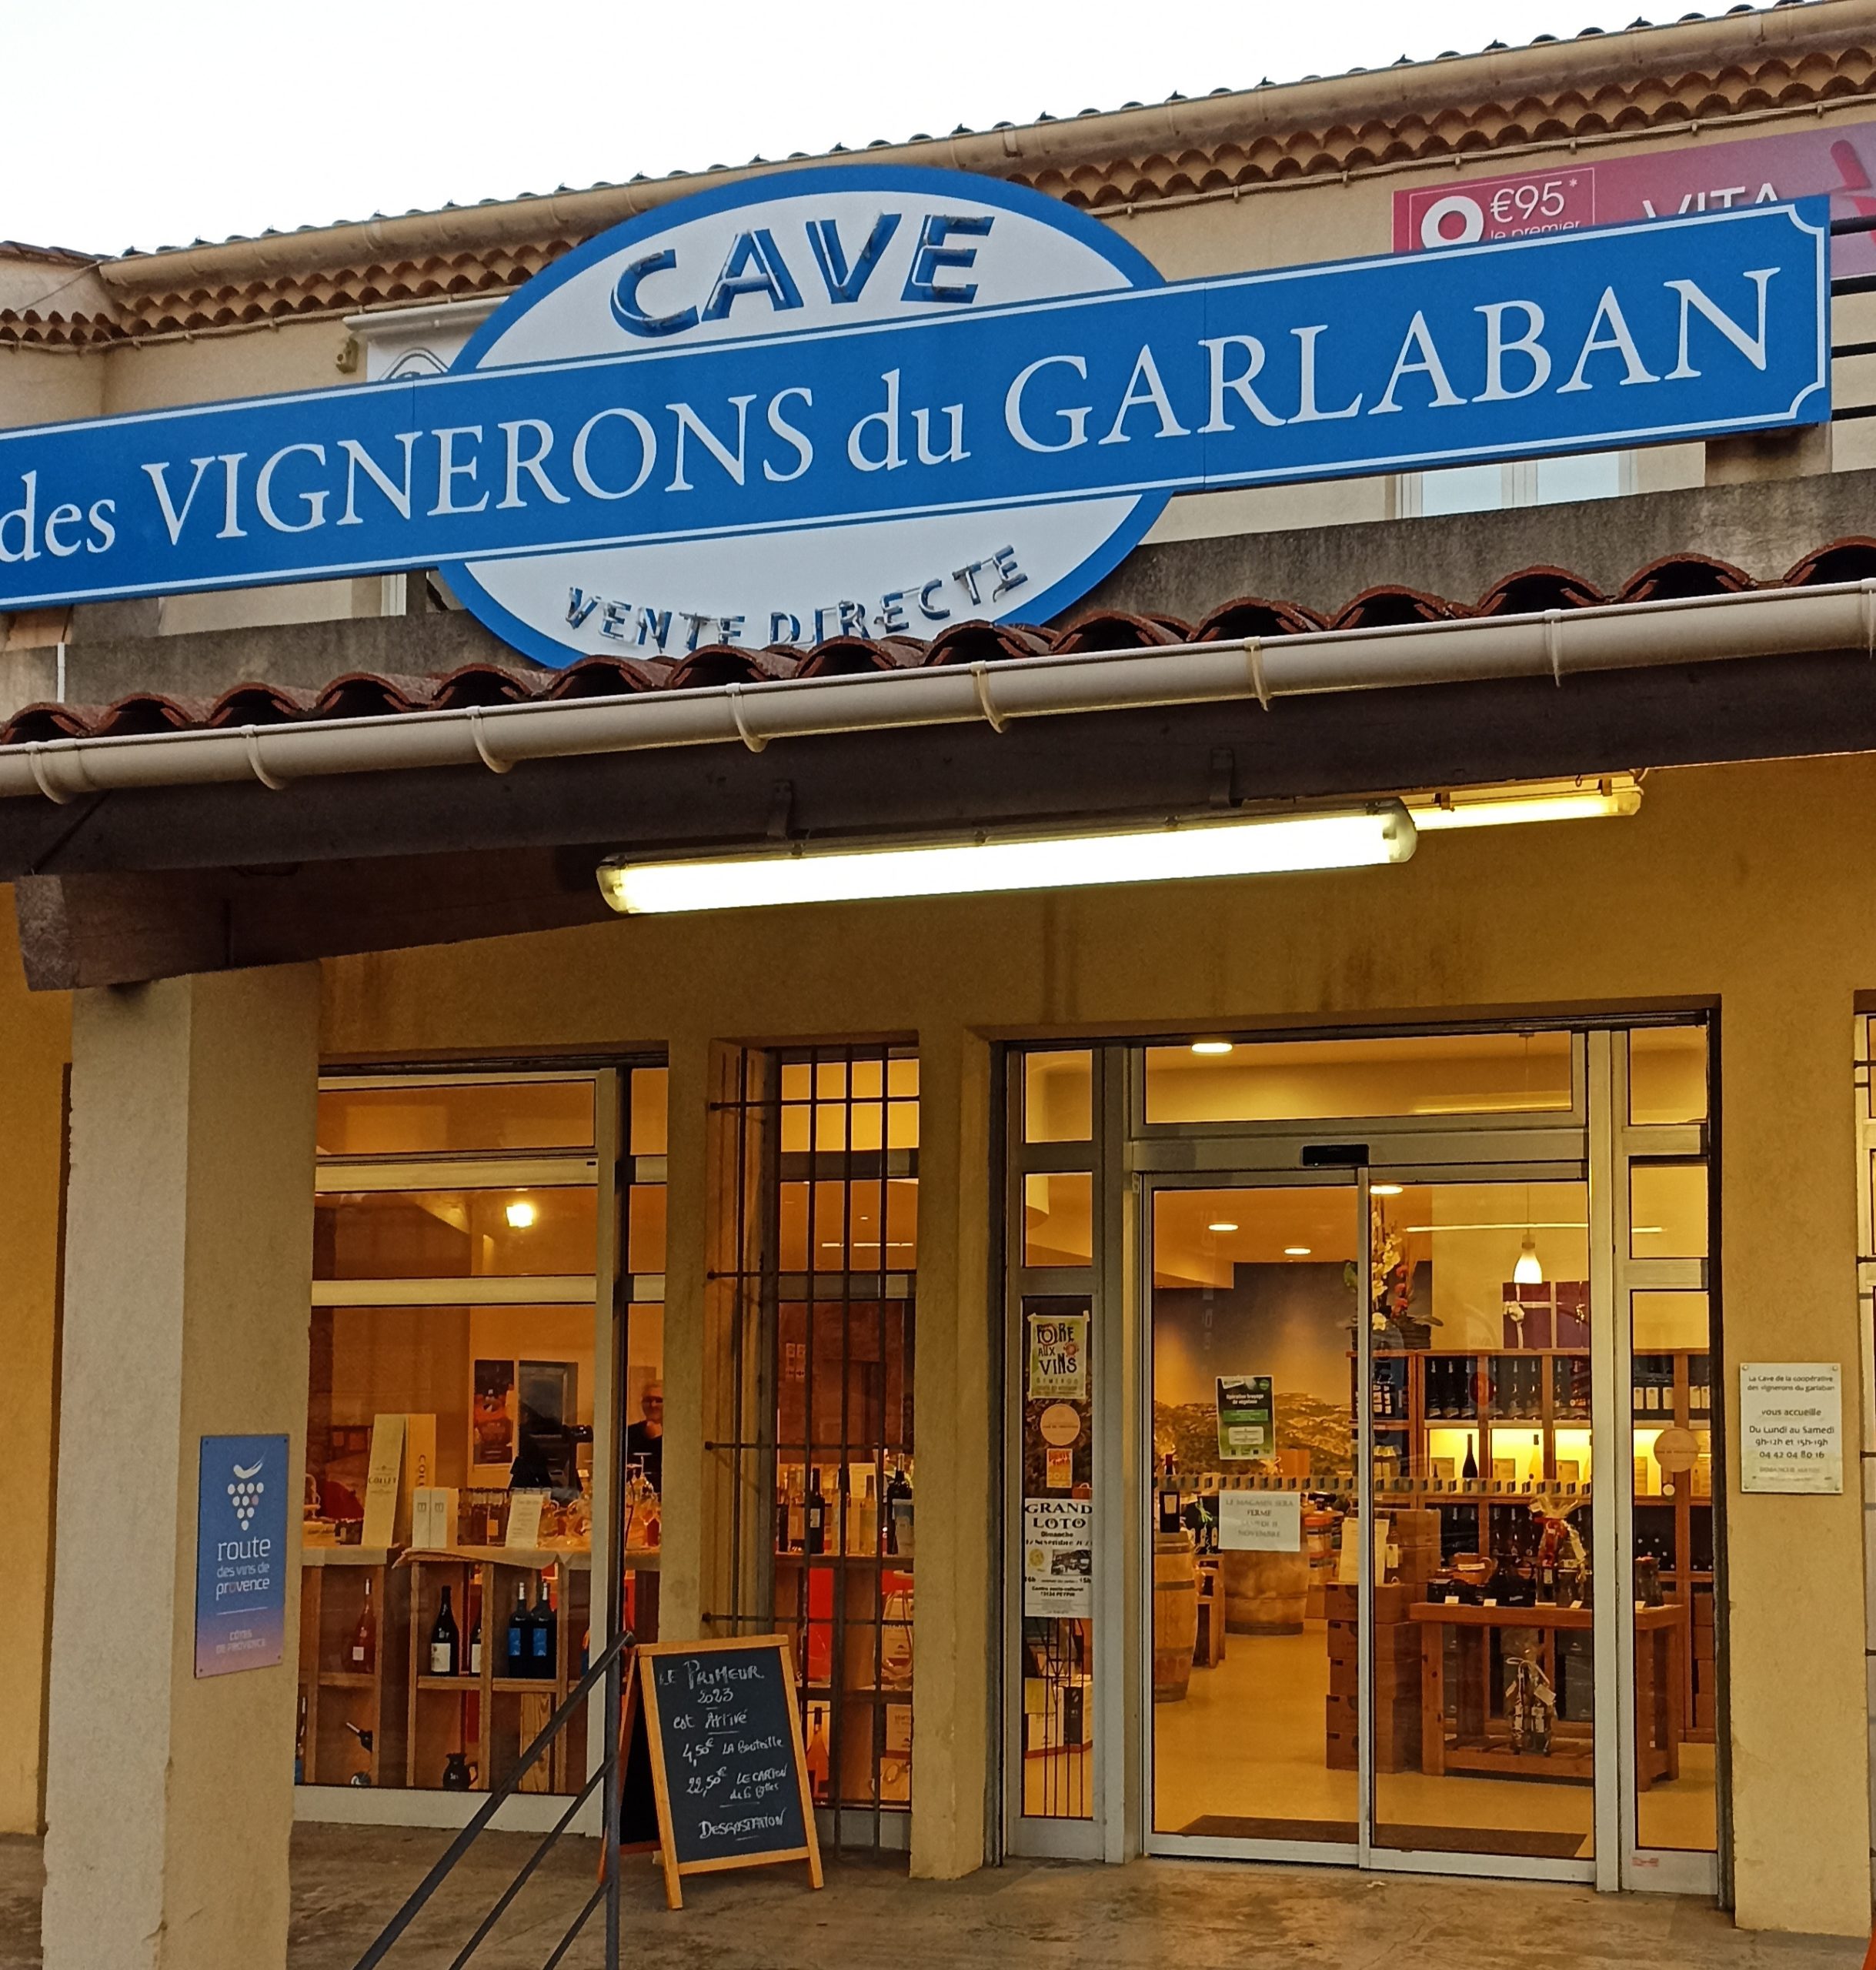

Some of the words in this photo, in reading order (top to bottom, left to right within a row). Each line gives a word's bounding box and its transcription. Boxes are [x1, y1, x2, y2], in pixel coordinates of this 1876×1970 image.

[610, 212, 994, 338] CAVE
[0, 470, 115, 563] des
[142, 388, 813, 546] VIGNERONS
[848, 369, 971, 472] du
[1006, 268, 1781, 452] GARLABAN
[565, 586, 745, 653] VENTE
[770, 544, 1029, 646] DIRECTE
[1039, 1353, 1077, 1375] VINS
[1784, 1407, 1822, 1417] accueille
[1749, 1425, 1761, 1434] Du
[1802, 1426, 1835, 1434] Samedi
[1025, 1502, 1093, 1514] GRAND
[1033, 1518, 1086, 1530] LOTO
[217, 1537, 271, 1561] route
[216, 1565, 235, 1578] des
[235, 1563, 256, 1576] vins
[257, 1561, 270, 1574] de
[215, 1578, 270, 1601] provence
[697, 1688, 734, 1704] 2023
[673, 1714, 695, 1730] est
[722, 1742, 735, 1755] LA
[736, 1771, 751, 1785] LE
